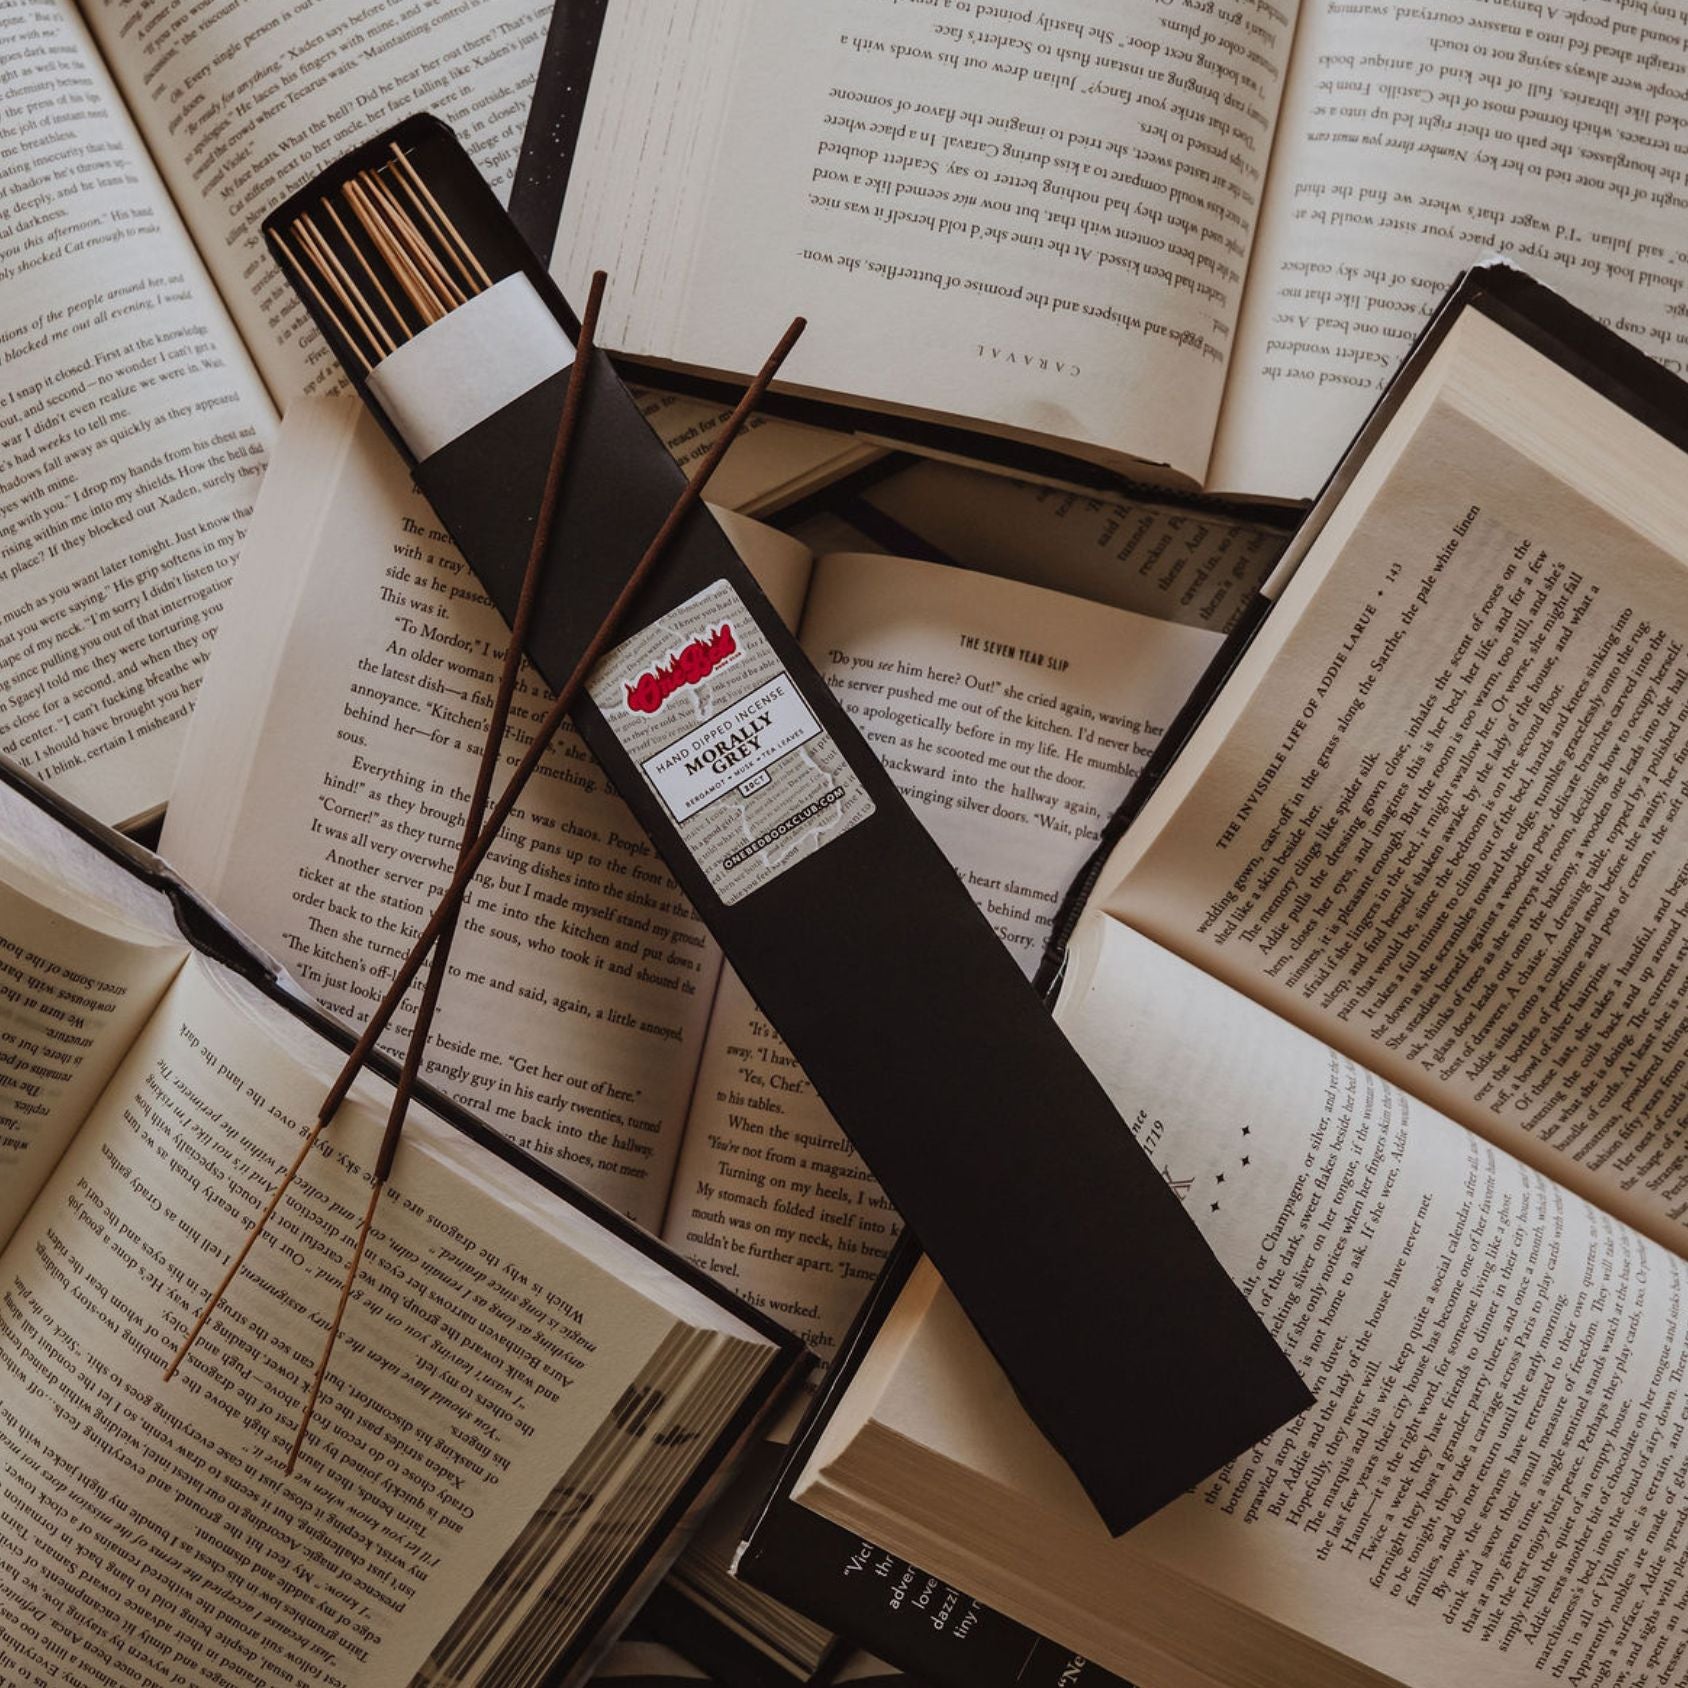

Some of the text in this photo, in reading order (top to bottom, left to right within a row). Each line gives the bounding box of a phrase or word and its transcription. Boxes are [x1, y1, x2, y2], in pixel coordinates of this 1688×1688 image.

[1319, 55, 1355, 70] books
[1359, 54, 1414, 70] antique
[1416, 63, 1434, 76] of
[1439, 66, 1473, 85] kind
[1478, 73, 1502, 89] the
[1506, 78, 1523, 93] of
[829, 88, 893, 107] someone
[1527, 83, 1553, 101] full
[895, 100, 912, 114] of
[913, 103, 956, 124] flavor
[959, 111, 983, 128] the
[987, 116, 1046, 140] imagine
[1049, 129, 1064, 141] to
[1067, 133, 1102, 149] tried
[1105, 142, 1129, 159] she
[837, 256, 861, 273] she
[943, 276, 961, 290] of
[964, 279, 1024, 299] promise
[1025, 292, 1049, 309] the
[1052, 298, 1080, 313] and
[1082, 305, 1141, 330] whispers
[1143, 321, 1167, 336] and
[3, 515, 230, 623] much as you want later tonight. Just know
[381, 586, 450, 619] This was it.
[960, 634, 1069, 672] THE SEVEN YEAR SLIP
[1384, 539, 1531, 776] close, inhales the scent of roses on the
[851, 657, 874, 671] you
[877, 661, 895, 672] see
[896, 660, 923, 677] him
[926, 666, 962, 685] here?
[964, 674, 1001, 693] Out!”
[1003, 684, 1024, 701] she
[1026, 693, 1058, 709] cried
[1059, 702, 1095, 721] again,
[1099, 712, 1142, 735] waving
[1143, 720, 1166, 740] her
[826, 673, 1130, 752] the server pushed me out of the kitchen. I’d never
[1196, 505, 1481, 934] wedding gown, cast-off in the grass along the Sarthe, the pale white linen
[655, 749, 690, 774] HAND
[691, 720, 733, 751] DIPPED
[734, 687, 785, 723] INCENSE
[1215, 821, 1241, 849] THE
[1236, 752, 1287, 822] INVISIBLE
[1282, 719, 1307, 752] LIFE
[1302, 698, 1318, 718] OF
[1316, 652, 1348, 698] ADDIE
[1343, 604, 1377, 652] LARUE
[684, 711, 772, 776] MORALLY
[711, 735, 761, 774] GREY
[352, 755, 470, 803] Everything in the
[685, 728, 804, 808] BERGAMOT MUSK TEA LEAVES
[723, 787, 845, 870] ONEBEDBOOKCLUB.COM
[476, 899, 693, 970] me into the kitchen and put down
[435, 1033, 477, 1058] beside
[479, 1051, 503, 1066] me.
[508, 1054, 539, 1076] “Get
[541, 1064, 565, 1083] her
[565, 1076, 589, 1090] out
[590, 1081, 606, 1094] of
[729, 1114, 764, 1135] When
[769, 1124, 790, 1140] the
[1143, 1120, 1164, 1155] 1719
[403, 1199, 584, 1325] Which is why the dragons are
[1358, 1300, 1499, 1560] Twice a week they have friends to dinner
[336, 1403, 466, 1490] Xaden strides past the
[283, 1604, 369, 1663] Tairn grumbles
[953, 1610, 978, 1639] tiny
